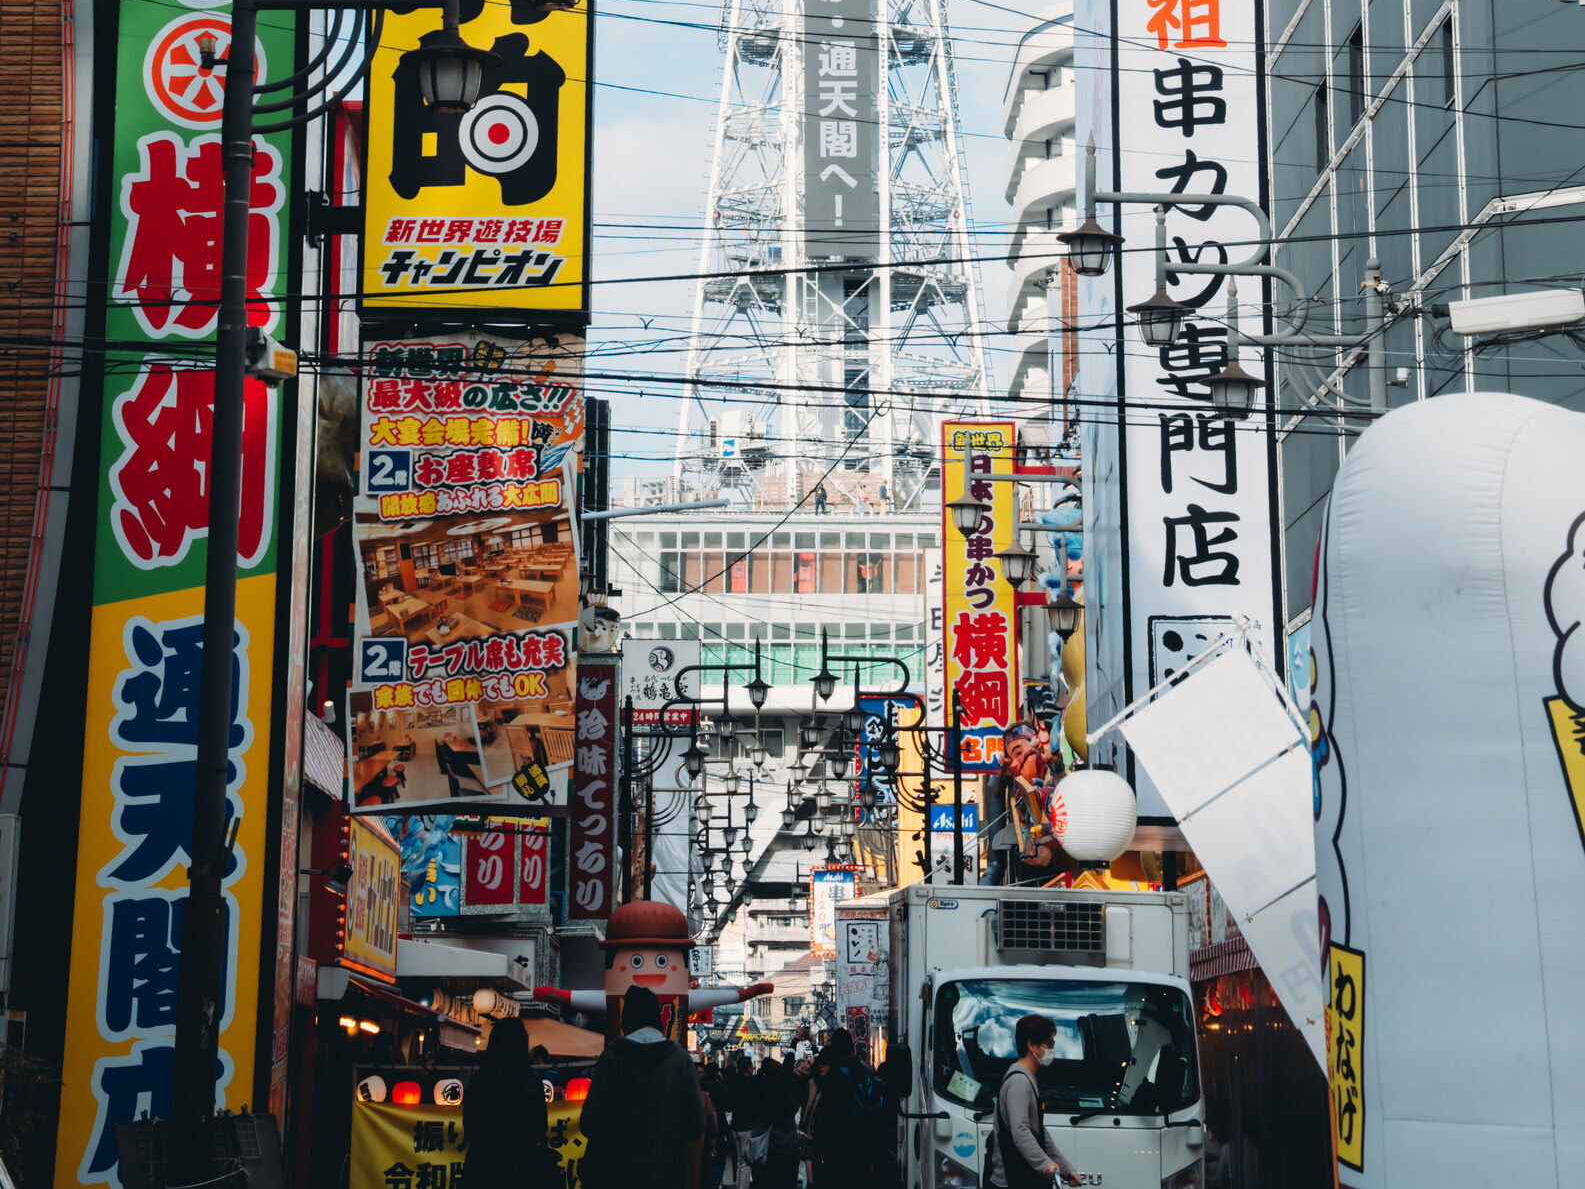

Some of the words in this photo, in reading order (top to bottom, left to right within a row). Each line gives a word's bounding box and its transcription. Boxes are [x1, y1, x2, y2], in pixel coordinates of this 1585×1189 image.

[382, 216, 565, 246] 新世界遊技場
[379, 248, 567, 287] チャンピオン
[415, 447, 538, 486] お座敷席
[380, 480, 562, 519] 開放感あふれる大広間
[408, 635, 565, 678] テーブル席も充実
[953, 611, 1009, 730] 横綱
[933, 812, 973, 829] Ashi
[1335, 961, 1358, 1146] わなげ
